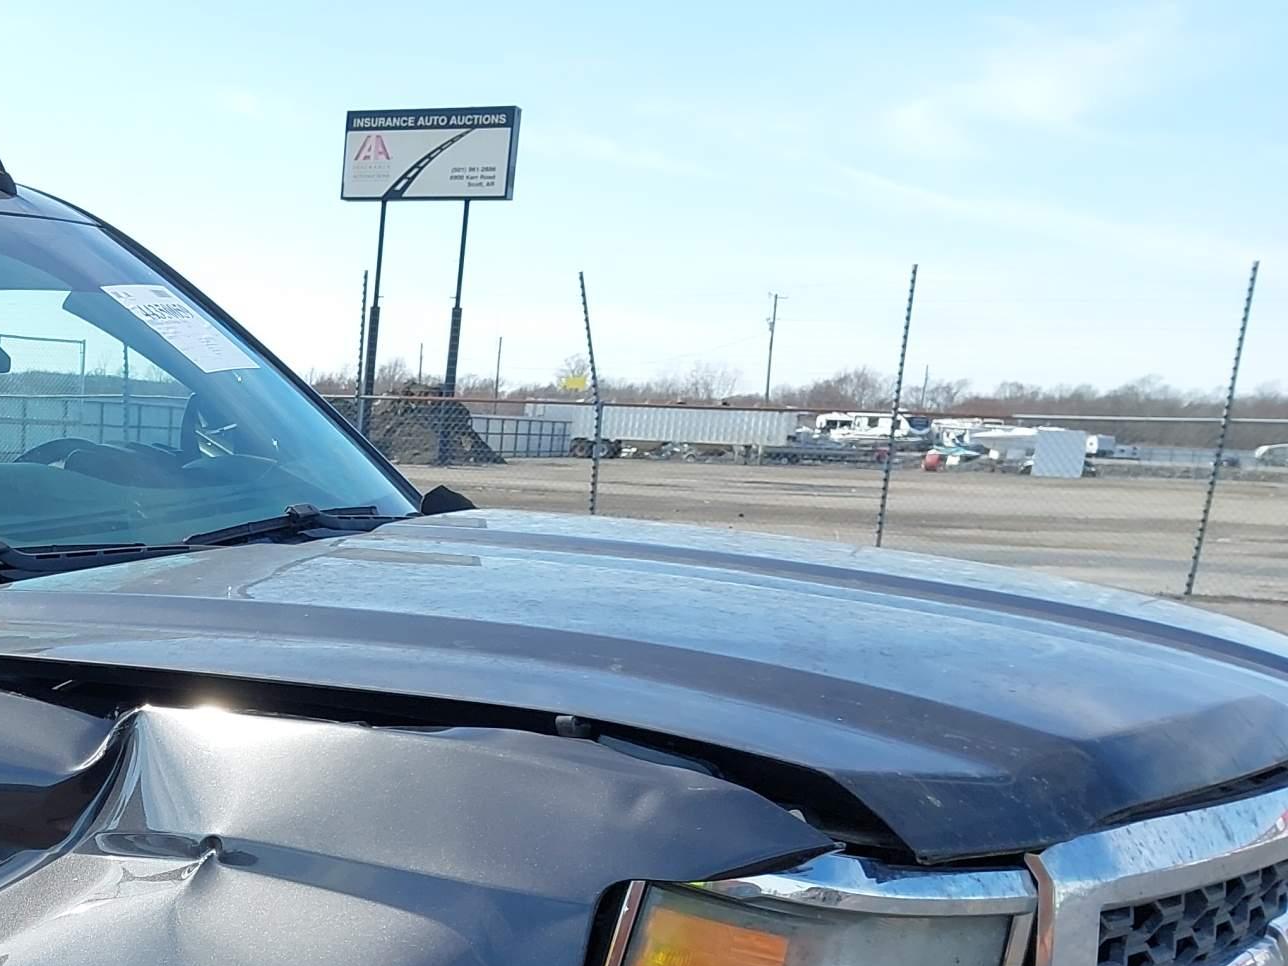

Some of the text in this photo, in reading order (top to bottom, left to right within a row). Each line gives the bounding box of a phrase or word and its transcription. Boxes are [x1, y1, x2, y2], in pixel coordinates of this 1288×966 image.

[353, 114, 506, 127] INSURANCE AUTO AUCTIONS
